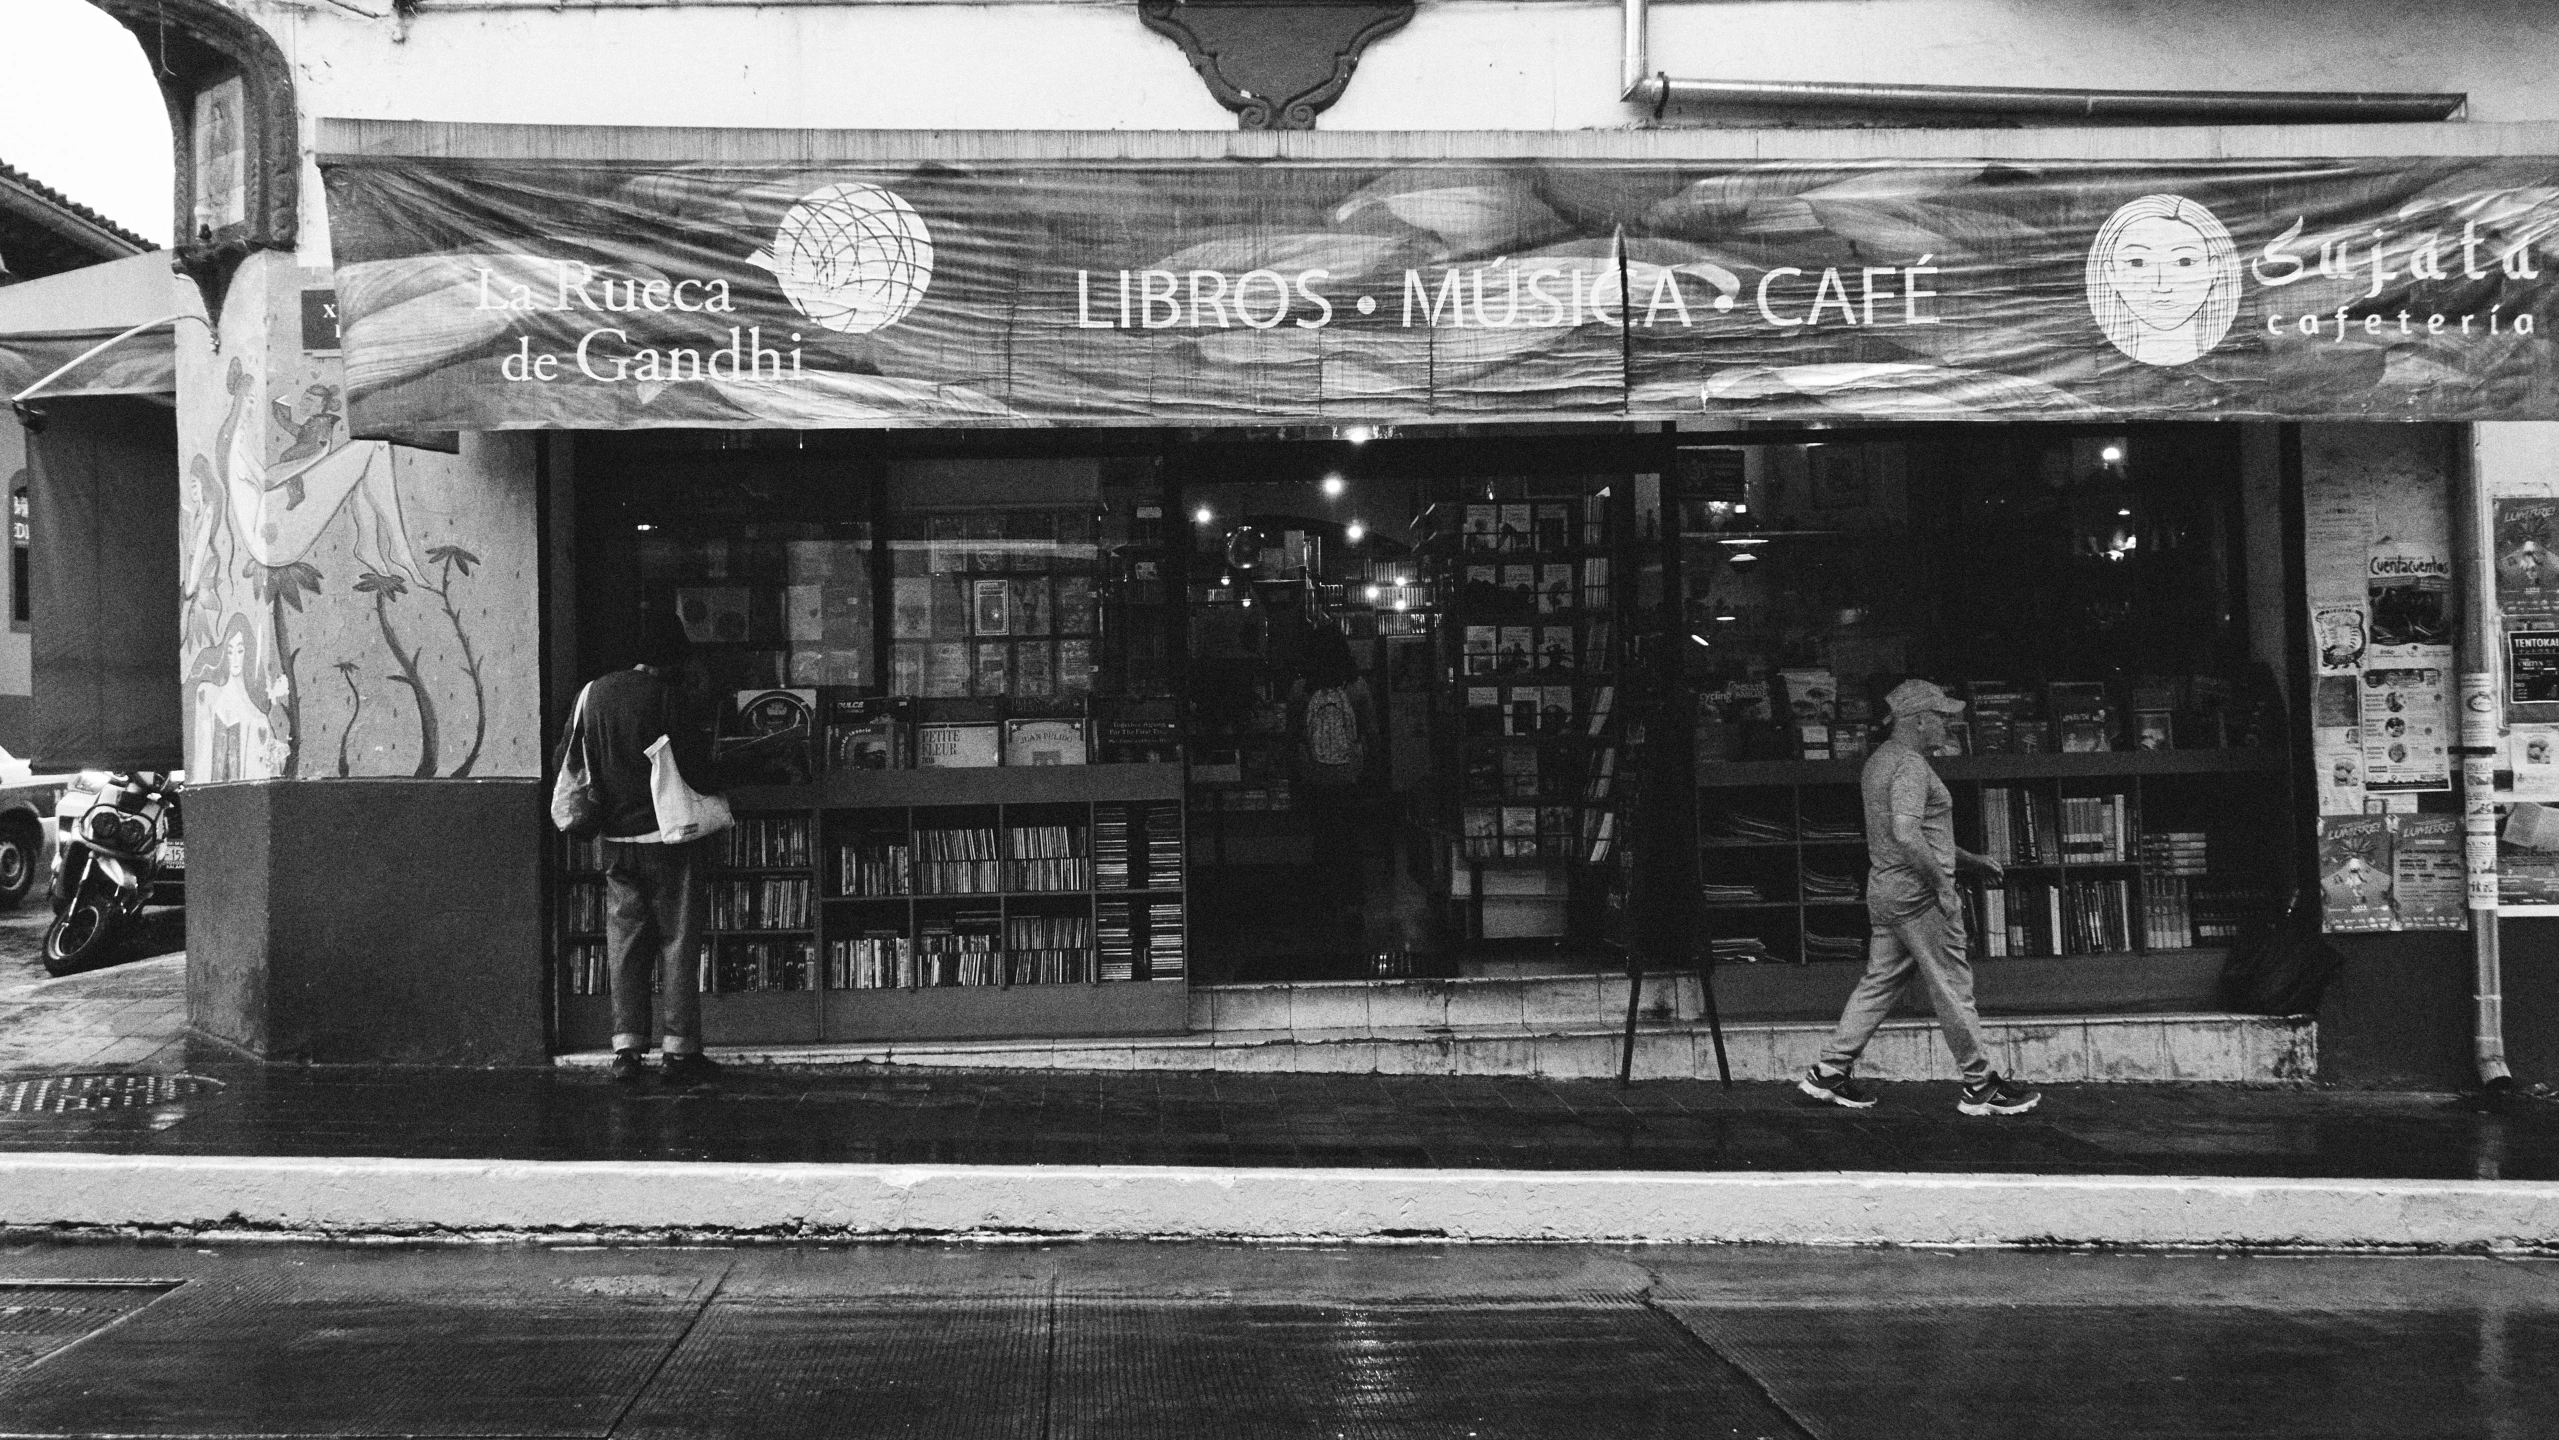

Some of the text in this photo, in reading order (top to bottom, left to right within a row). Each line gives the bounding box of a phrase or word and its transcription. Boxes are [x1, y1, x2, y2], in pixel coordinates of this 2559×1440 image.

[2252, 215, 2538, 298] Sujata
[475, 260, 736, 313] La Rueca
[1078, 254, 1940, 328] LIBROS MÚSICA CAFÉ
[2267, 304, 2535, 343] cafetería
[501, 325, 803, 383] de Gandhi
[921, 729, 961, 743] PETITE
[921, 742, 957, 756] FLEUR
